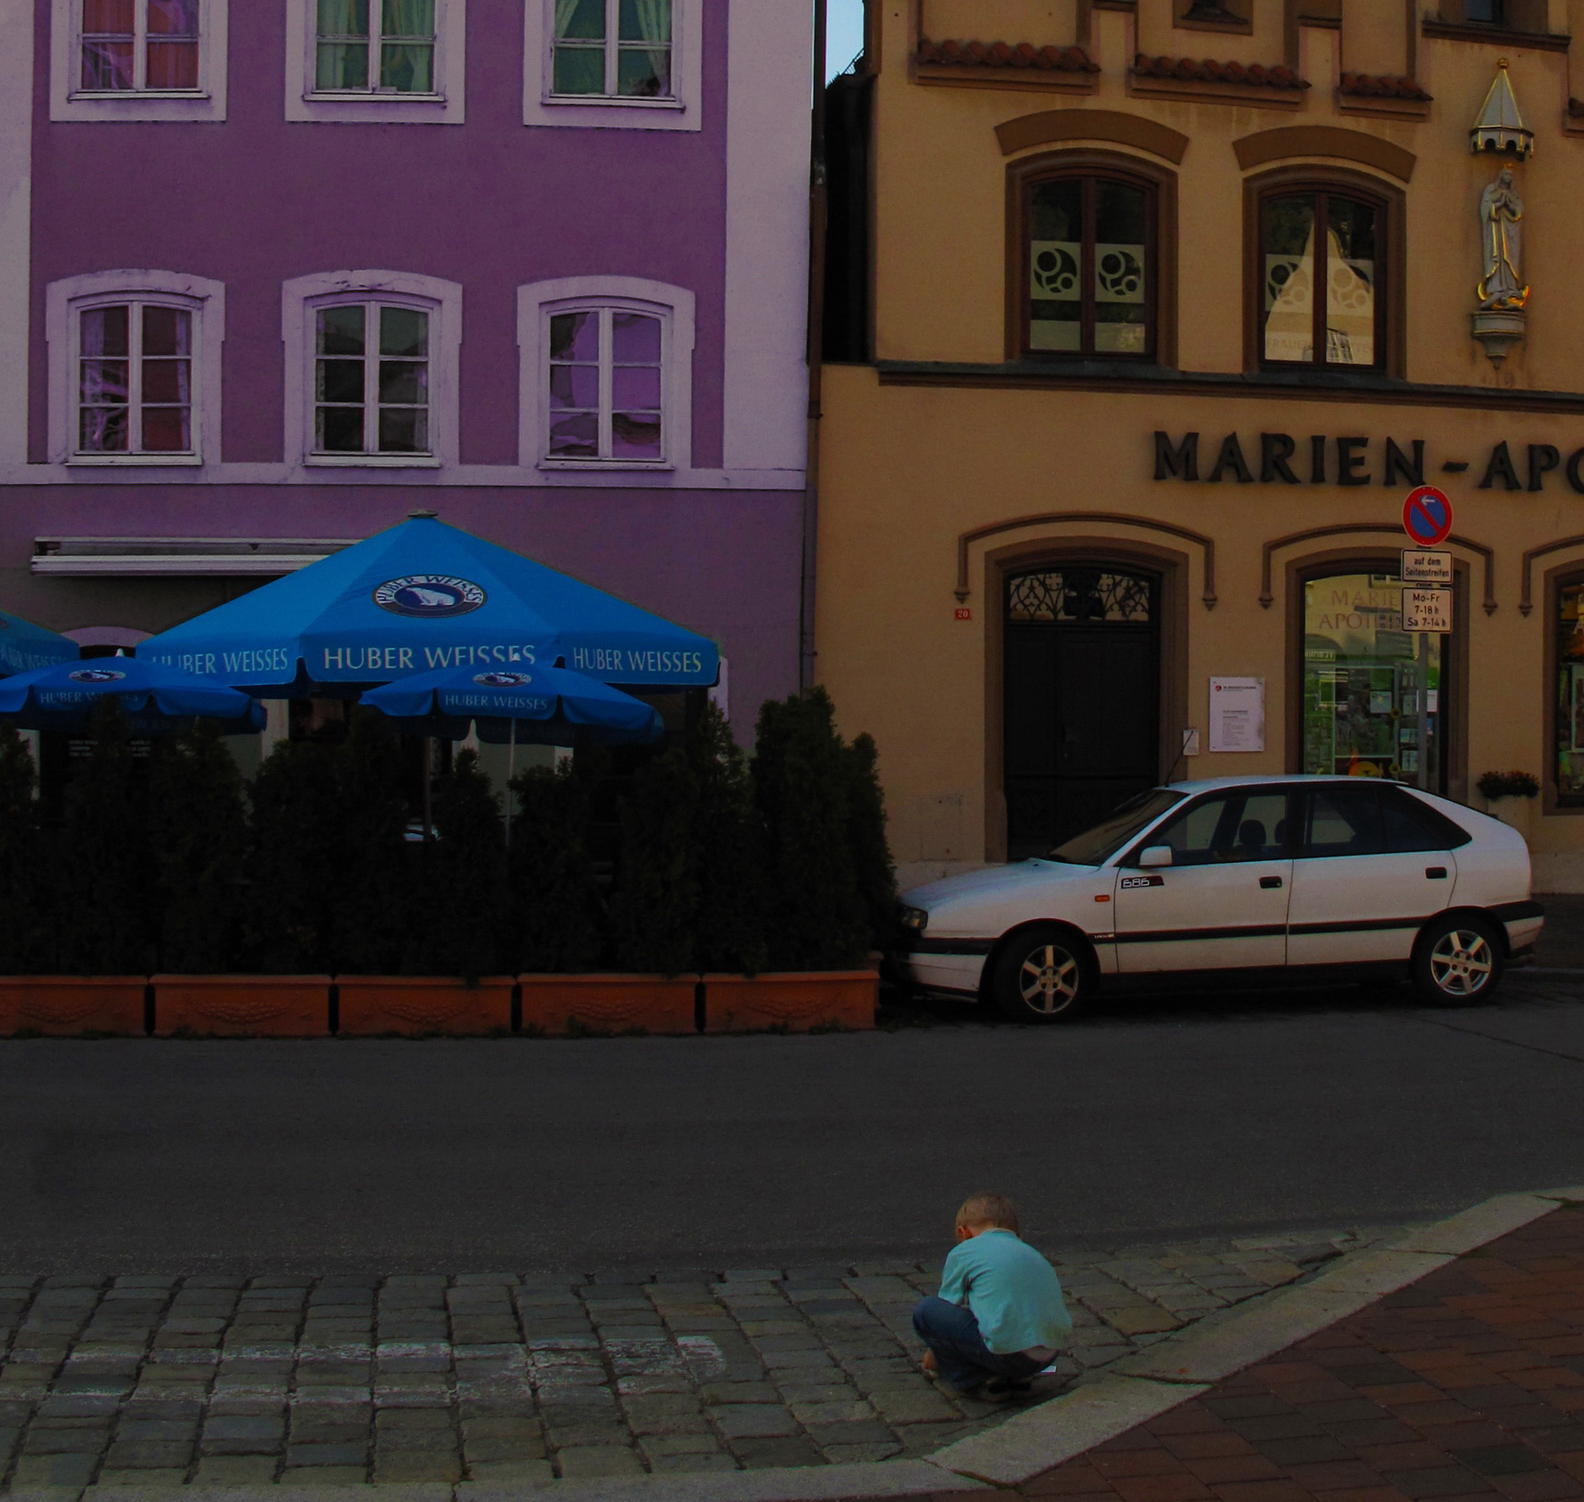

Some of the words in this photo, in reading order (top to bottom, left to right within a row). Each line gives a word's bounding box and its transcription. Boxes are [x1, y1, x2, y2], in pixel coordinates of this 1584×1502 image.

[1414, 557, 1425, 567] auf
[1428, 557, 1441, 567] dem
[1405, 567, 1450, 579] Seitenstreifen
[376, 576, 418, 604] HUBER
[424, 575, 484, 604] WEISSES
[1332, 590, 1400, 606] MARIE
[1413, 593, 1440, 603] Mo-Fr
[957, 610, 969, 619] 20
[1414, 605, 1433, 615] 7-18
[1434, 605, 1439, 614] h
[1407, 617, 1420, 628] Sa
[1422, 617, 1440, 627] 7-14
[1441, 617, 1446, 627] h
[222, 648, 288, 674] WEISSES
[324, 646, 421, 669] HUBER
[424, 644, 535, 669] WEISSES
[573, 647, 624, 670] HUBER
[626, 650, 703, 674] WEISSES
[40, 691, 82, 704] HUBER
[445, 694, 487, 707] HUBER
[490, 695, 548, 711] WEISSES
